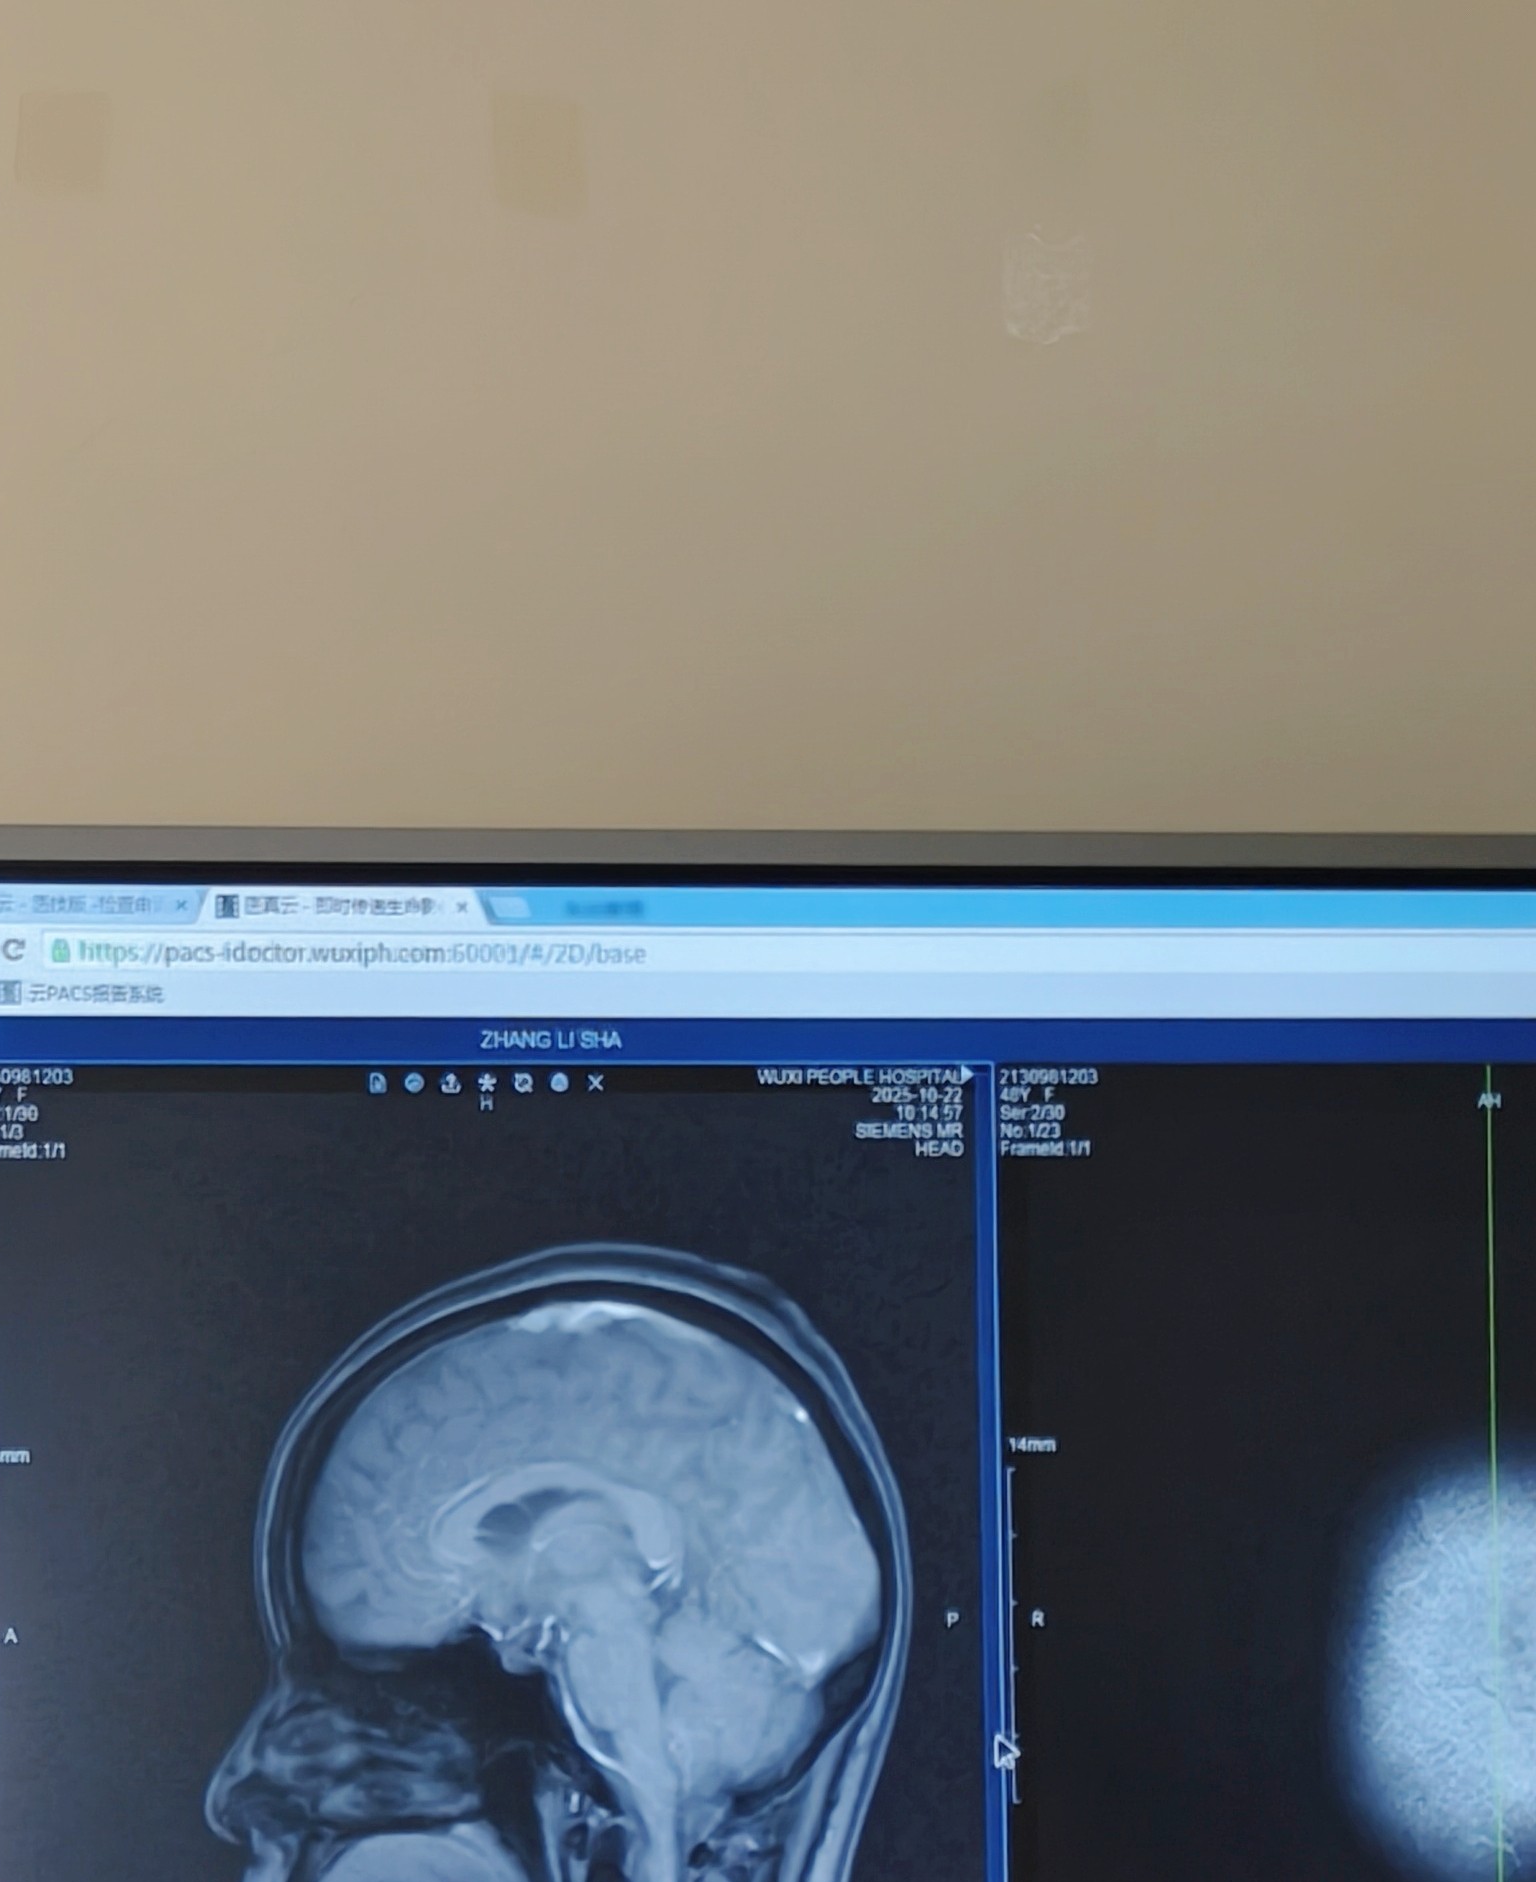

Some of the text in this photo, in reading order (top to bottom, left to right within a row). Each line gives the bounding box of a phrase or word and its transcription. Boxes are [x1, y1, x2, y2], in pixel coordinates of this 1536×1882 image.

[480, 1030, 623, 1049] ZHANG LI SHA
[807, 1069, 874, 1085] PEOPLE
[17, 1087, 28, 1102] F
[855, 1122, 963, 1139] SIEMENS MR
[915, 1141, 964, 1157] HEAD
